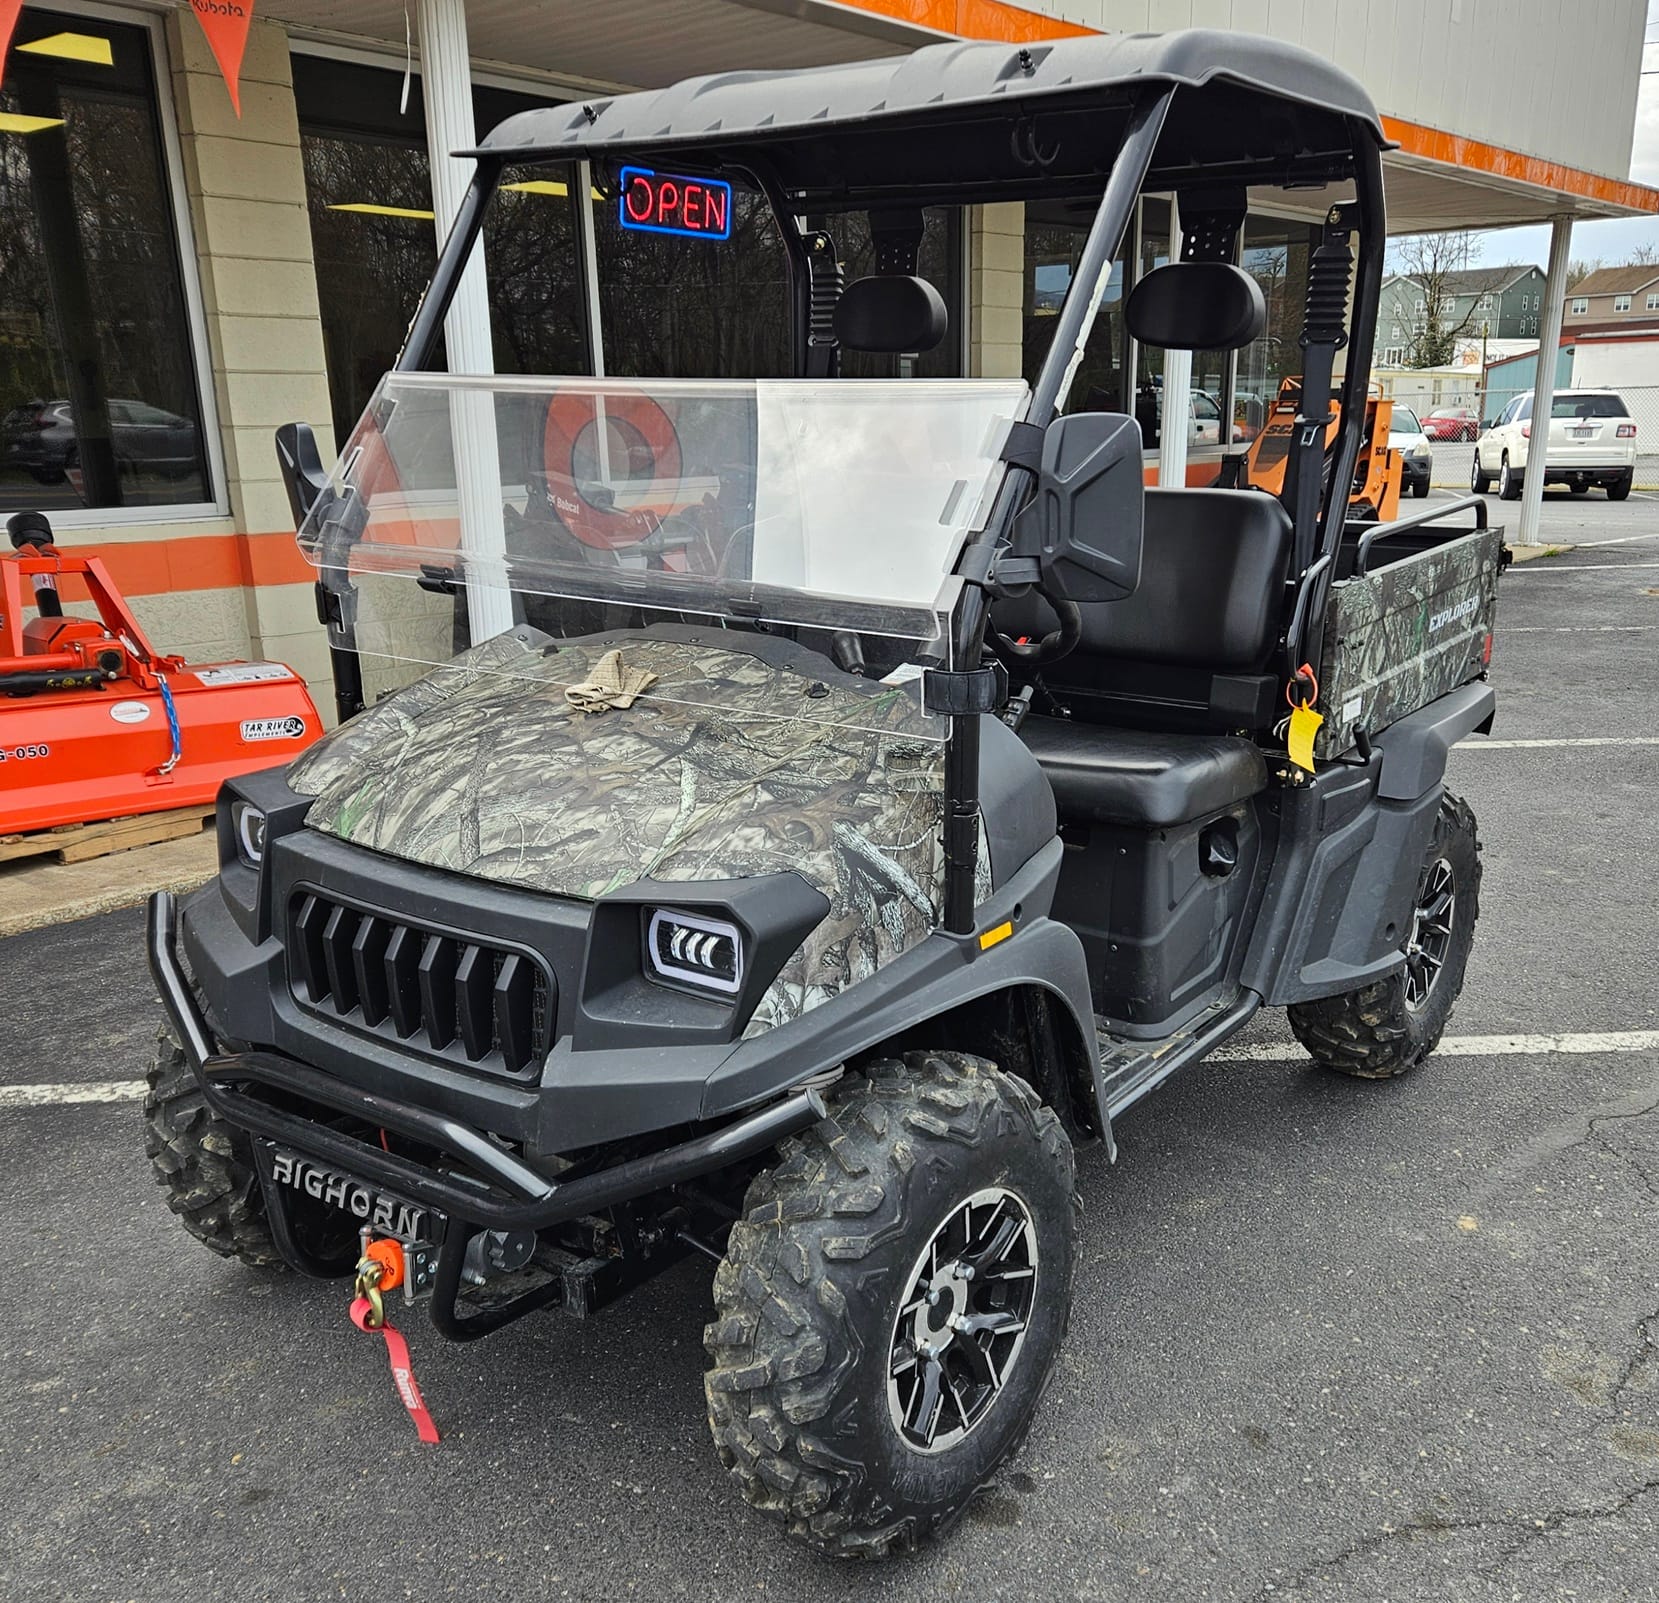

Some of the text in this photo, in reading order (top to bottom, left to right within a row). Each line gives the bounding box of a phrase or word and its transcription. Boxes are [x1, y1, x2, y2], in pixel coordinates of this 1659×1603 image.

[193, 0, 243, 16] Kubota
[626, 177, 725, 231] OPEN
[557, 496, 580, 515] Bobcat
[1428, 595, 1481, 633] EXPLORER
[245, 720, 295, 732] TAR RIVER
[272, 1152, 424, 1243] BIGHORN
